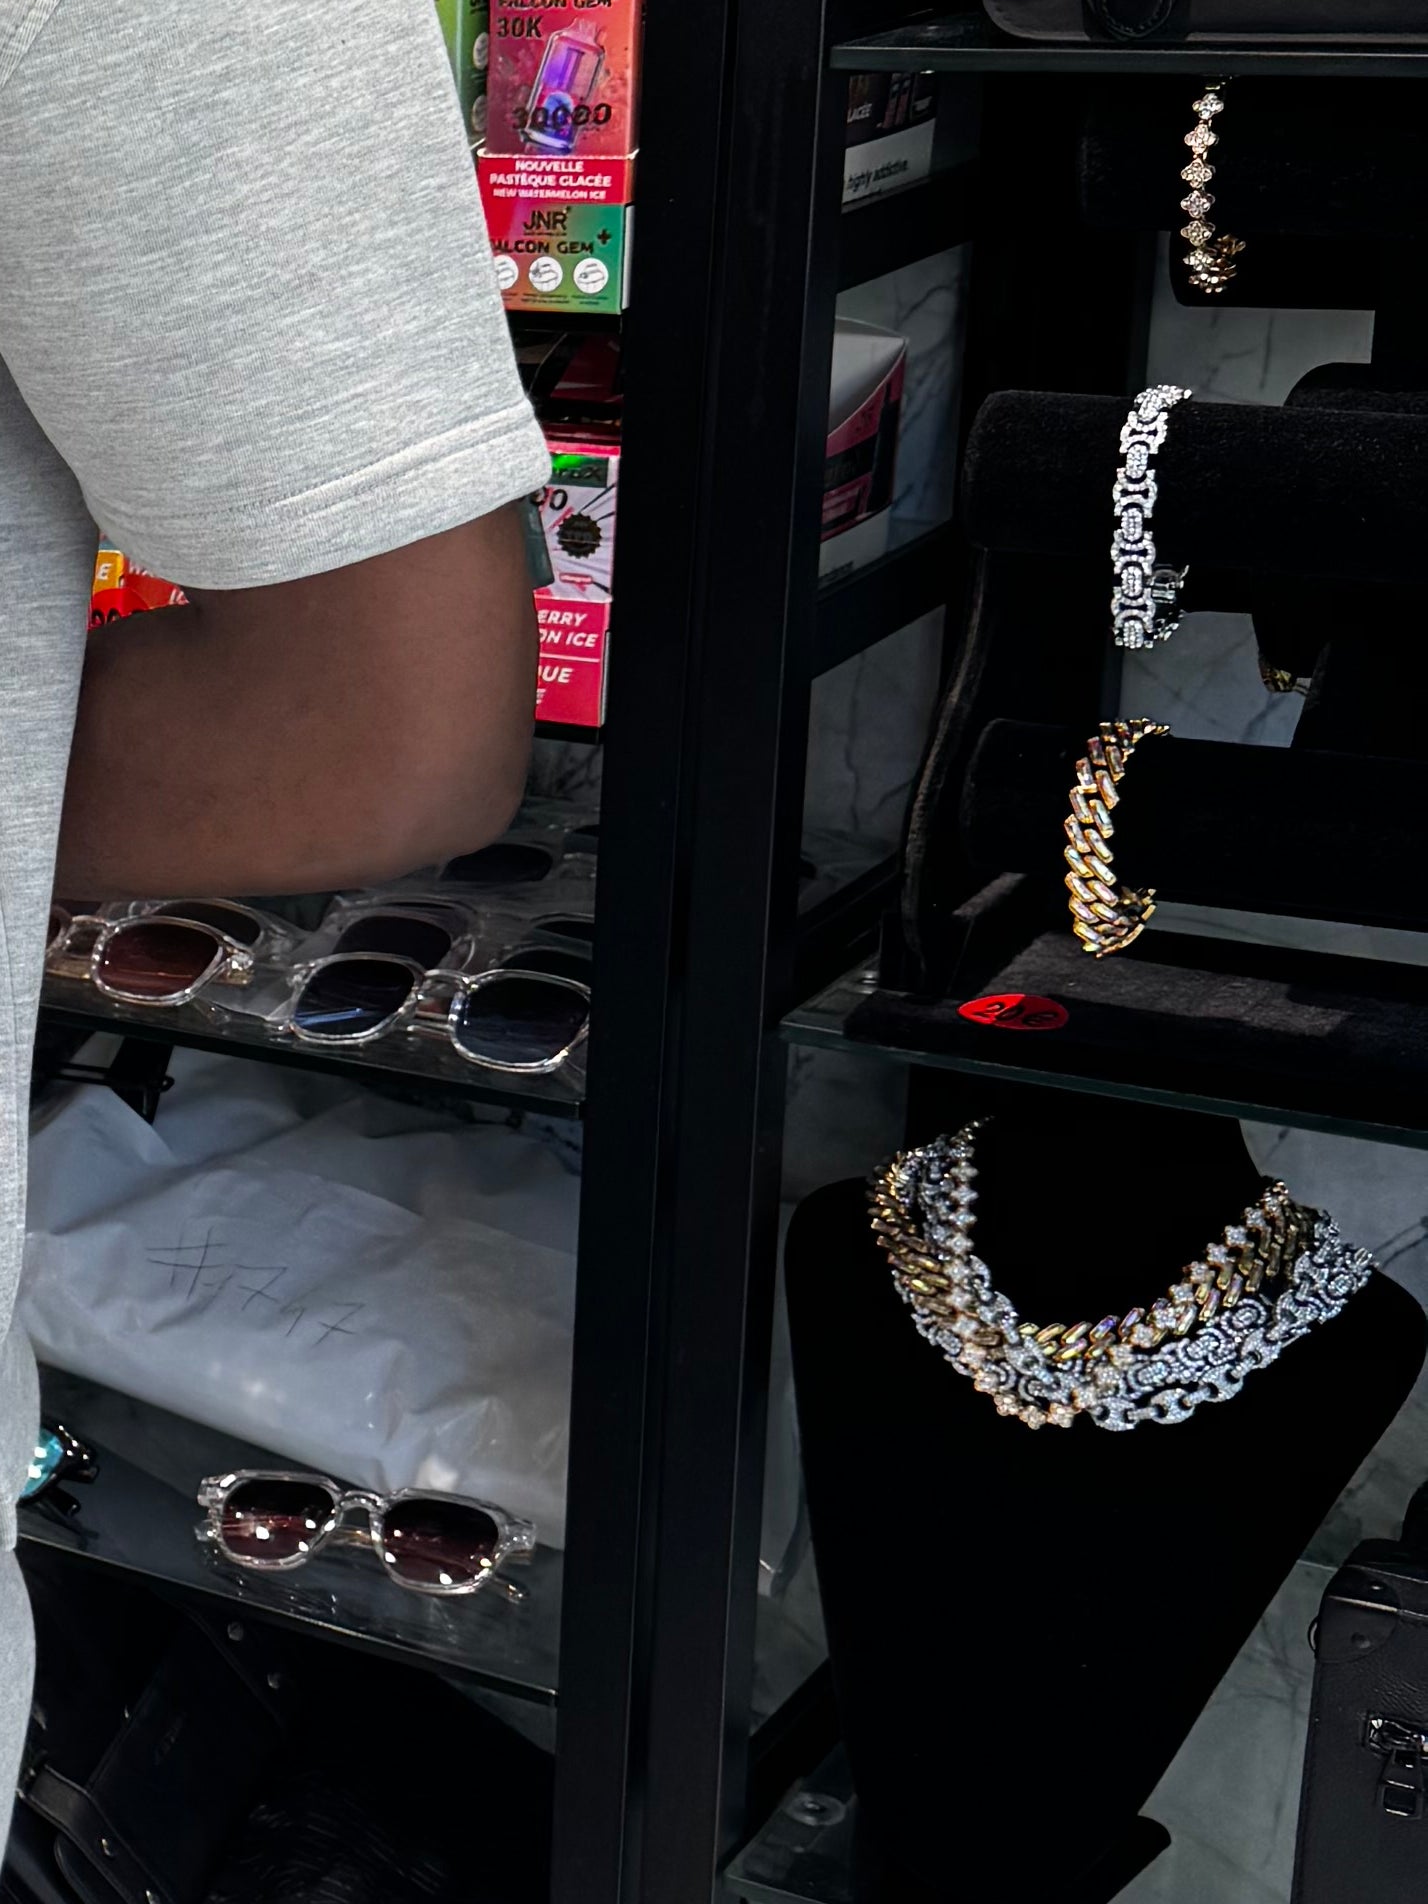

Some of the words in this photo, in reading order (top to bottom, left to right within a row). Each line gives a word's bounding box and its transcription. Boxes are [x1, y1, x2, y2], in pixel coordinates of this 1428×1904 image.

[497, 15, 543, 39] 30K
[515, 160, 584, 173] NOUVELLE
[523, 209, 568, 231] JNR
[565, 631, 599, 648] ICE
